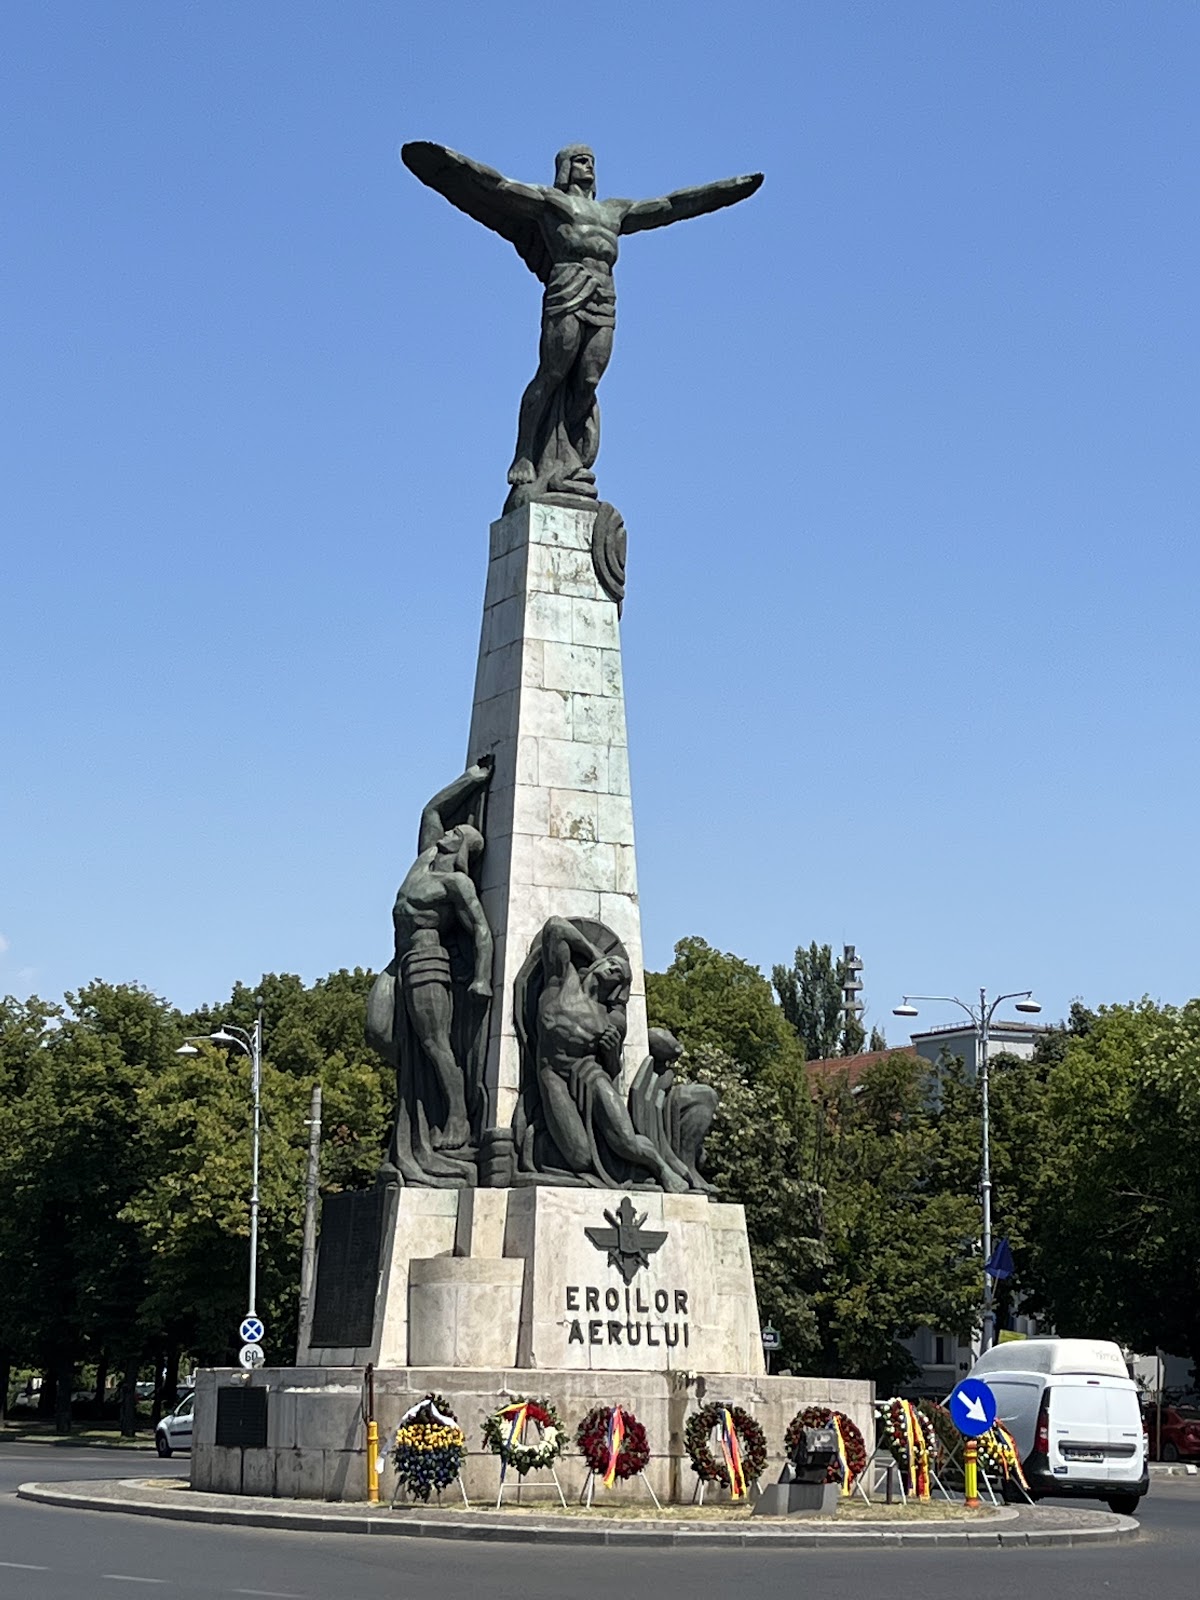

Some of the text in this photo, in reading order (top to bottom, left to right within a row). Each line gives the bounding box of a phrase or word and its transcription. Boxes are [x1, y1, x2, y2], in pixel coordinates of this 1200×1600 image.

[566, 1286, 688, 1315] EROILOR
[568, 1319, 689, 1348] AERULUI
[245, 1350, 258, 1362] 60
